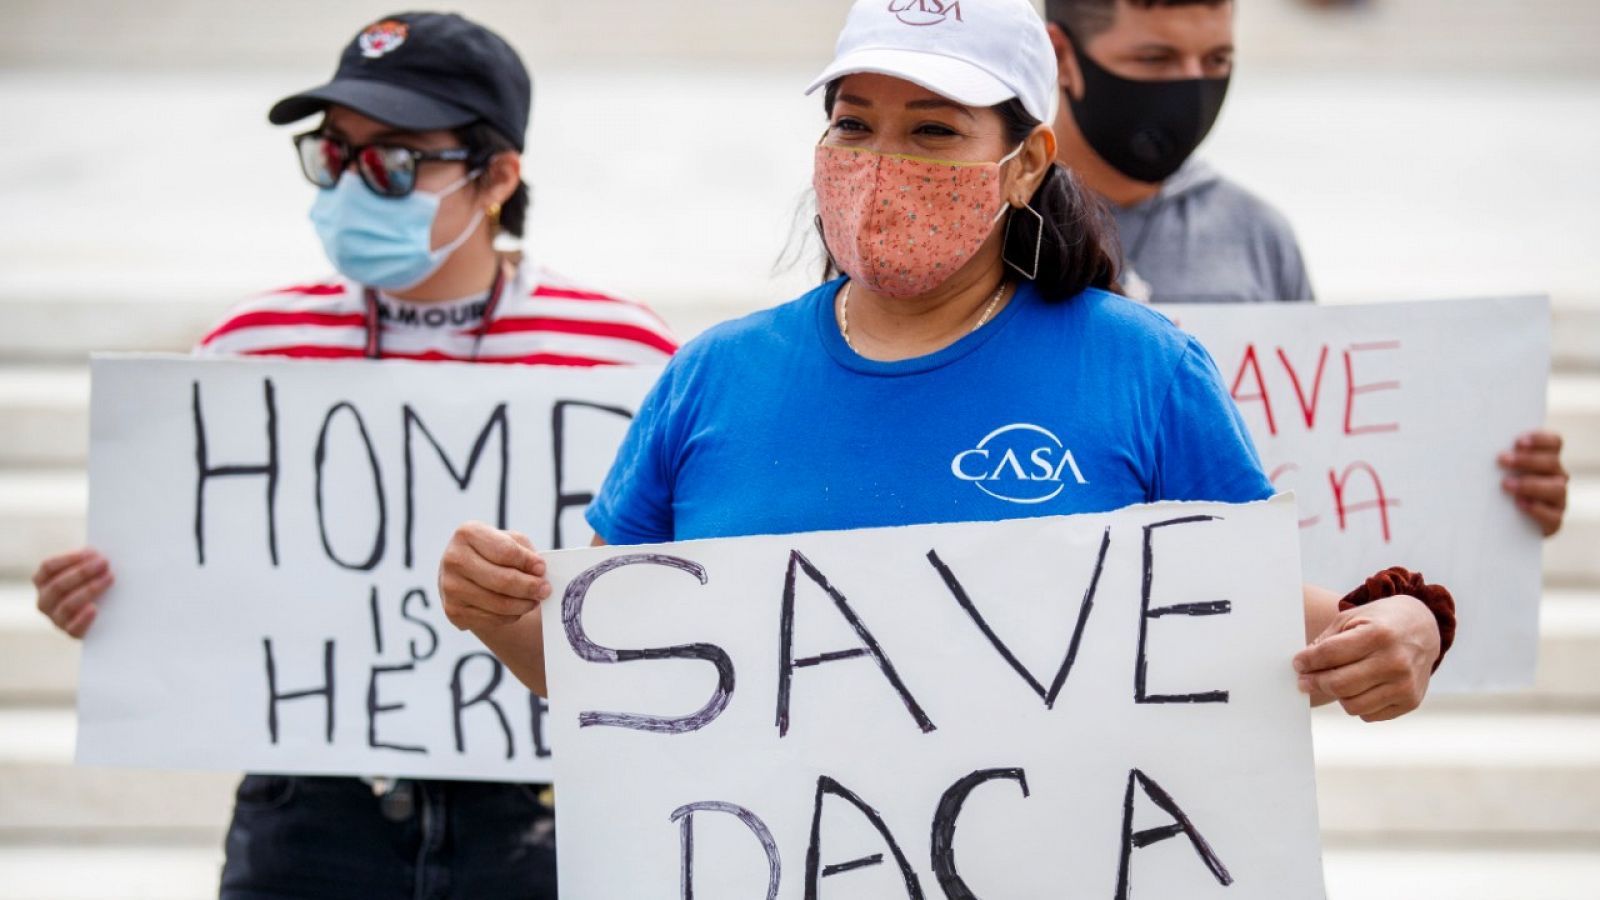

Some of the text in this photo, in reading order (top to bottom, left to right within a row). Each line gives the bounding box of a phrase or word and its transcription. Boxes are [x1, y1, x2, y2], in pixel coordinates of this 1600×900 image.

[1229, 340, 1401, 436] AVE
[951, 447, 1090, 484] CASA
[369, 585, 438, 660] IS
[561, 514, 1231, 736] SAVE
[669, 767, 1233, 900] DACA
